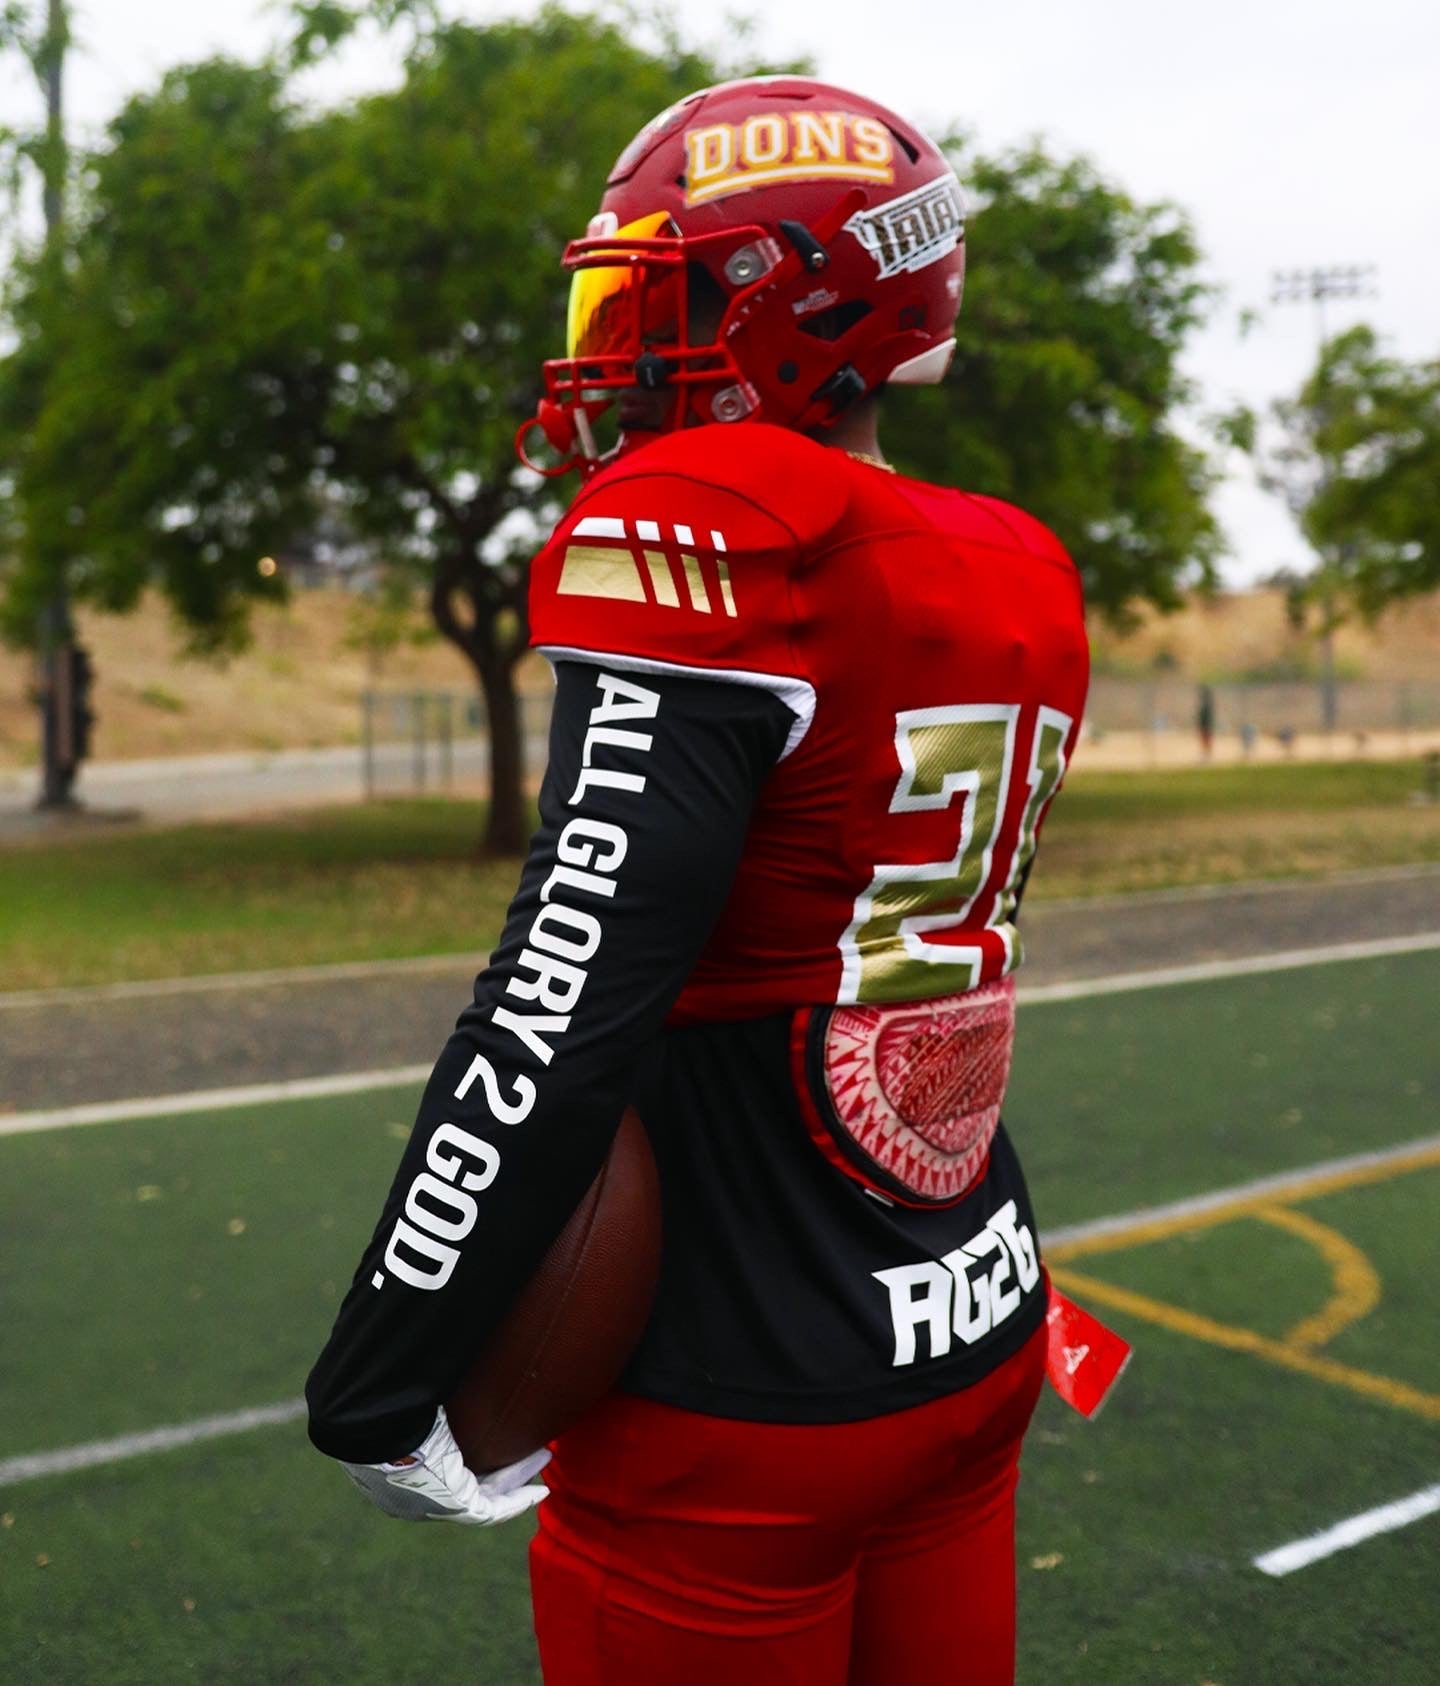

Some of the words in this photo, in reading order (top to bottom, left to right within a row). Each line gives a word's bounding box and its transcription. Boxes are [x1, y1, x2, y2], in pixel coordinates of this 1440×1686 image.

[688, 112, 893, 183] DONS
[568, 674, 660, 805] ALL
[492, 818, 627, 1065] GLORY
[454, 1054, 536, 1124] 2
[372, 1123, 500, 1290] GOD.
[872, 1200, 1040, 1366] AG26
